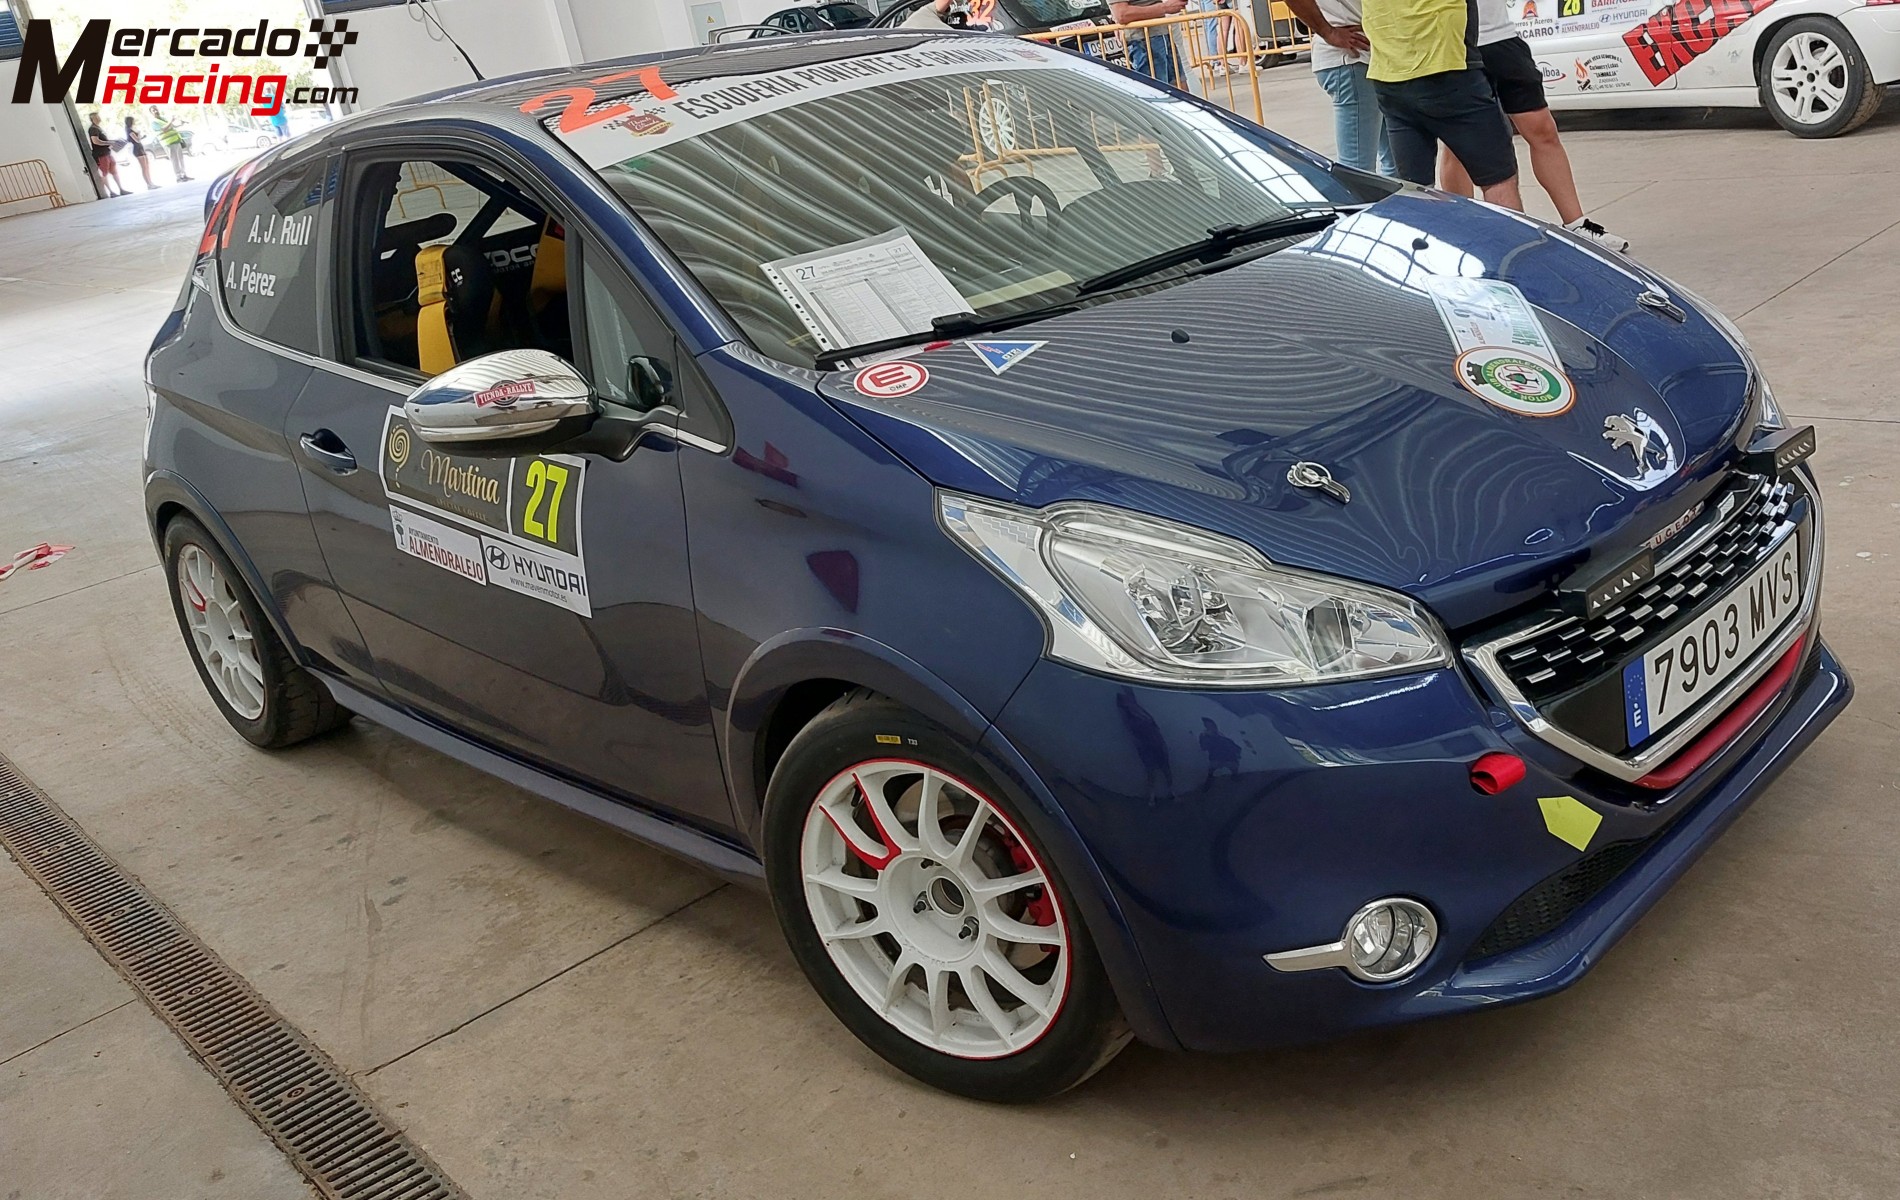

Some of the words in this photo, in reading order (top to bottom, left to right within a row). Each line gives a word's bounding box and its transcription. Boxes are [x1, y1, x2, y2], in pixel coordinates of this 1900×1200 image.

[1561, 22, 1600, 34] ALMENDRALEJO
[1612, 9, 1648, 21] HYUNDAI
[520, 65, 679, 134] 27
[672, 75, 809, 120] ESCUDERIA
[793, 56, 893, 86] PONIENTE
[891, 51, 935, 71] DE
[929, 48, 1016, 66] GRANADA
[280, 214, 313, 246] Rull
[225, 261, 237, 290] A.
[240, 262, 276, 297] Pérez
[796, 265, 816, 281] 27
[420, 449, 500, 505] Martina
[523, 460, 569, 544] 27
[408, 527, 440, 546] AYUNTAMIENTO
[409, 535, 484, 582] ALMENDRALEJO
[512, 554, 586, 597] HYUNDAI
[1654, 603, 1740, 715] 7903
[1749, 551, 1794, 640] MVS
